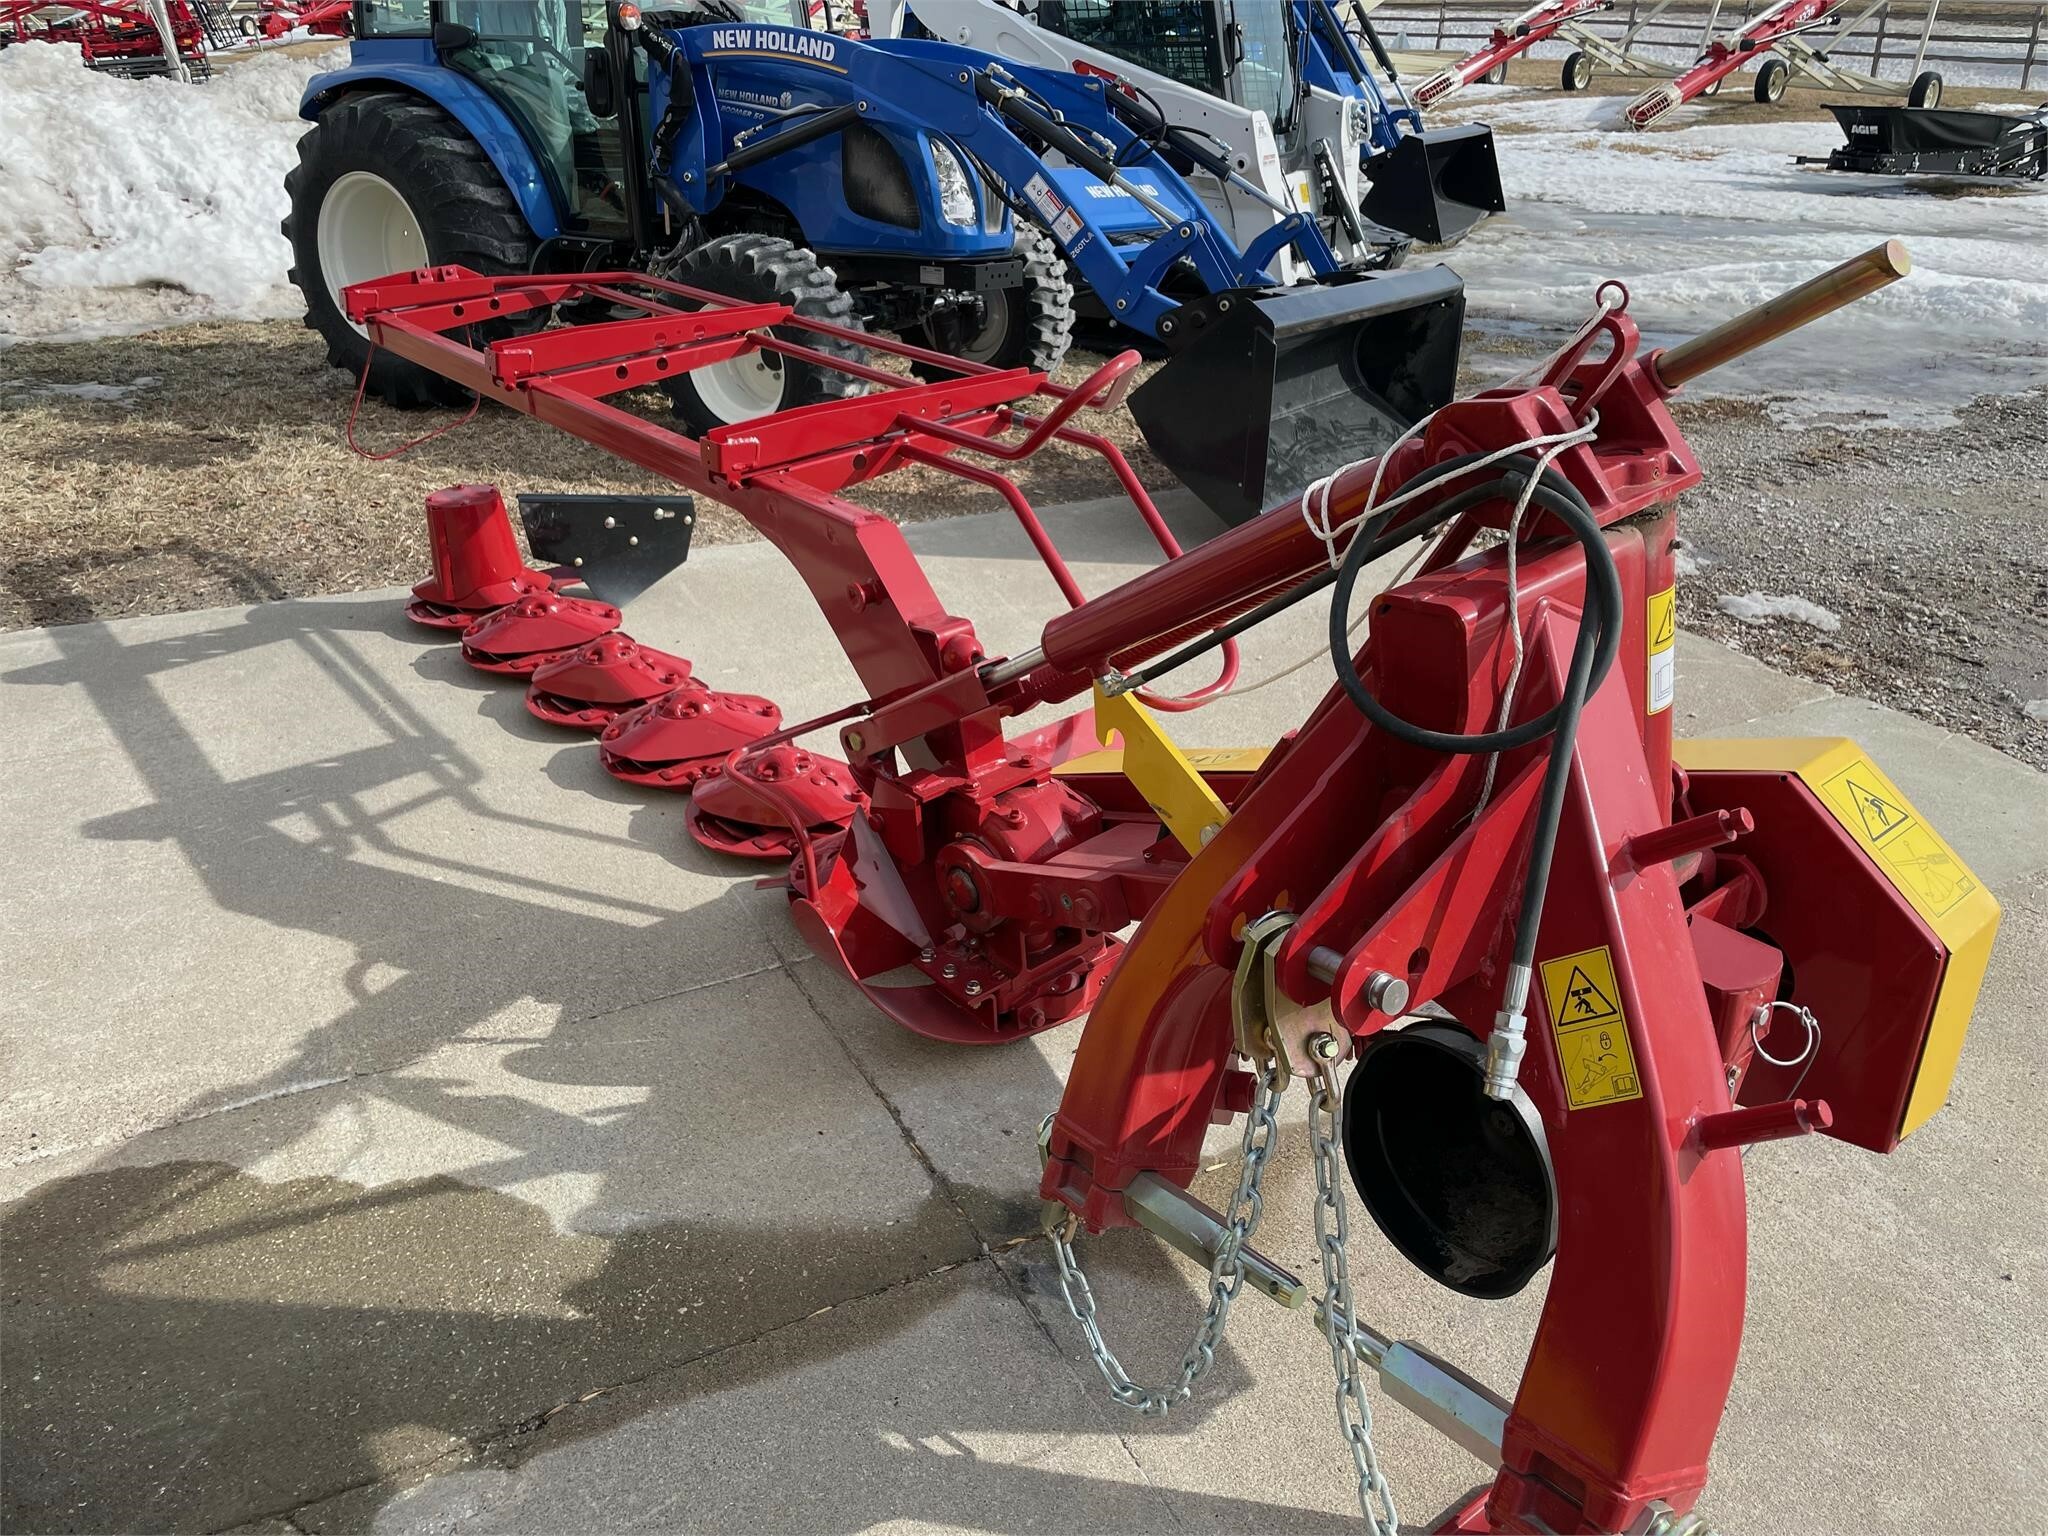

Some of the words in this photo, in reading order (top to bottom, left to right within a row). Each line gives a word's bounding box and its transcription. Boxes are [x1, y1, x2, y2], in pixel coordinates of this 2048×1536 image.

[713, 29, 751, 49] NEW
[755, 30, 835, 61] HOLLAND
[718, 88, 738, 99] NEW
[739, 91, 778, 106] HOLLAND
[1085, 184, 1115, 199] NEW
